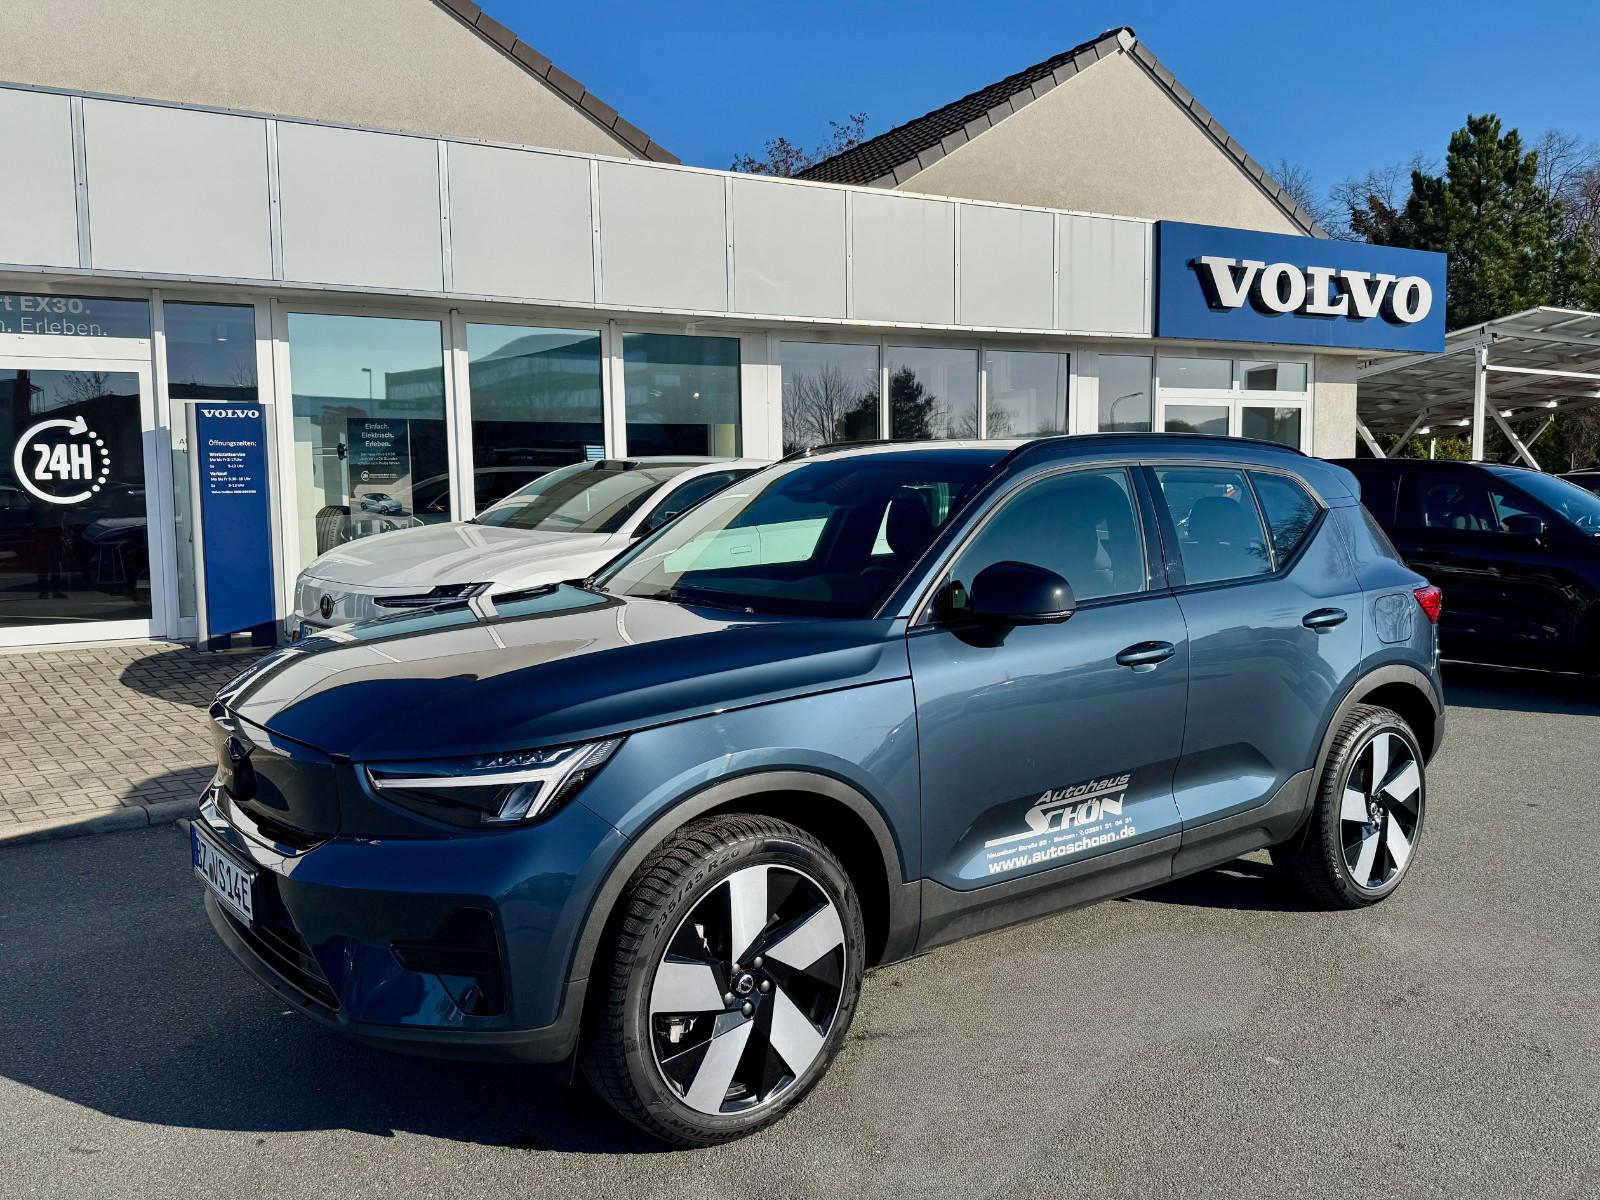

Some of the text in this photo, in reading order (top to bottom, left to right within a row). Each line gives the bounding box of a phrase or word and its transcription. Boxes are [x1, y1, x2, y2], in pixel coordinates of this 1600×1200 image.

[1201, 255, 1433, 324] VOLVO
[0, 296, 91, 315] t EX30.
[20, 317, 108, 336] Erleben.
[201, 409, 260, 419] VOLVO
[208, 439, 257, 448] Öffnungszeiten:
[33, 443, 93, 480] 24H
[1033, 773, 1131, 806] Autohaus
[988, 825, 1137, 874] www.autoschoen.de
